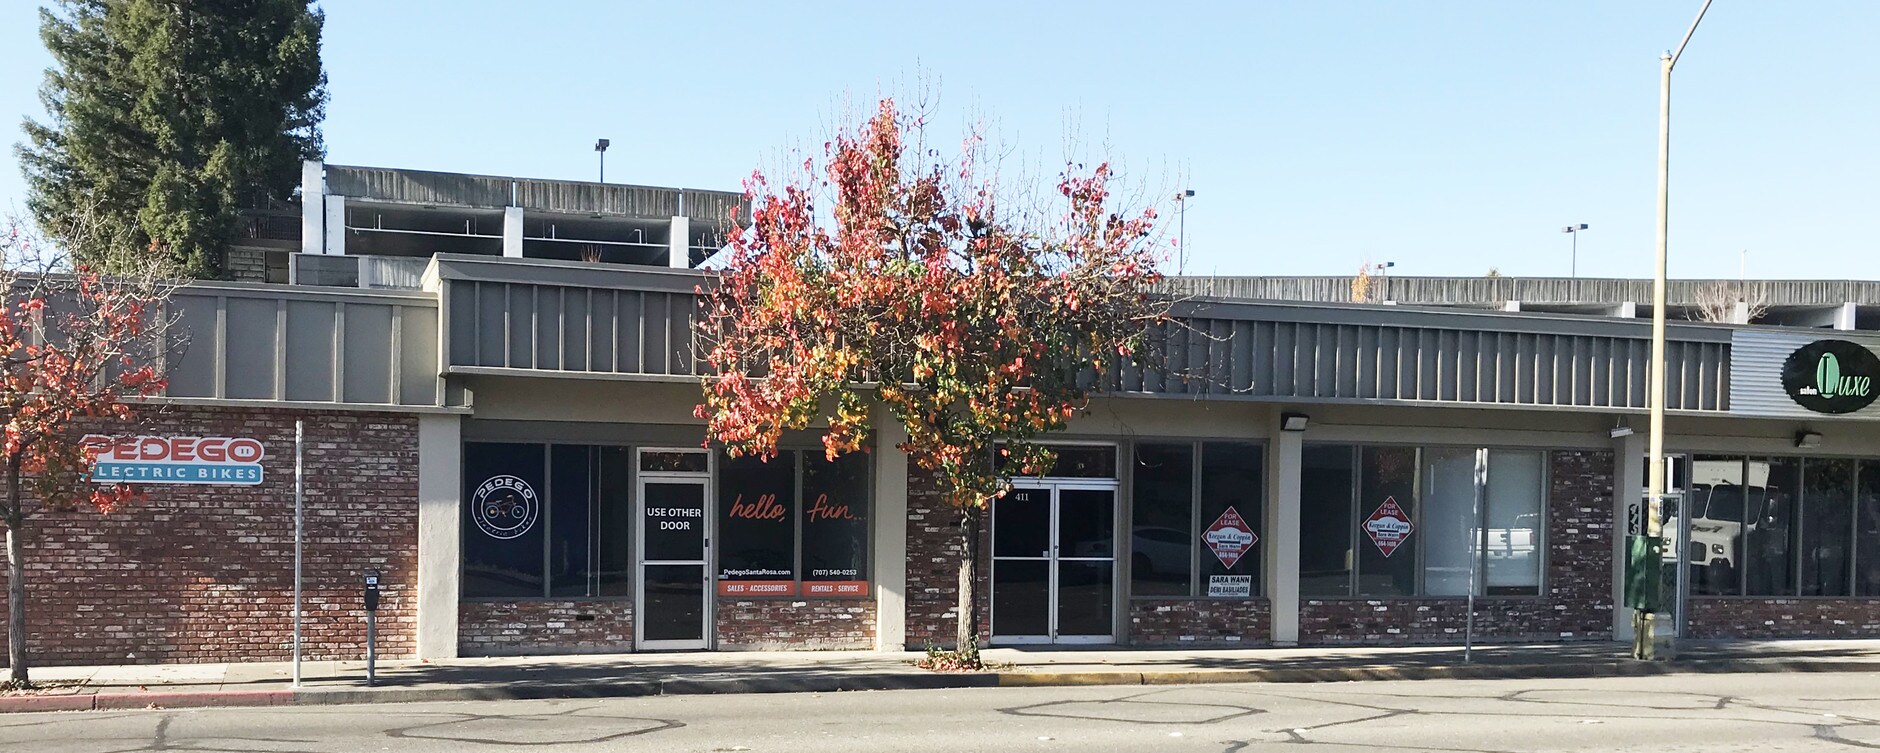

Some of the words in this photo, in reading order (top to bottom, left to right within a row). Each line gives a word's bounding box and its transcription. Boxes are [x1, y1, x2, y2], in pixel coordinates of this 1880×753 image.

[1800, 385, 1817, 395] salon
[1817, 352, 1870, 398] Luxe
[80, 437, 262, 463] PEDEGO
[97, 466, 187, 479] LECTRIC
[198, 468, 256, 479] BIKES
[478, 478, 533, 499] PEDEGO
[1015, 493, 1029, 501] 411
[647, 508, 667, 517] USE
[668, 508, 702, 518] OTHER
[729, 493, 786, 523] hello,
[1630, 504, 1639, 535] 415
[660, 521, 690, 530] DOOR
[1211, 576, 1229, 584] SARA
[1230, 576, 1250, 584] WANN
[727, 584, 744, 593] SALES
[749, 584, 788, 593] ACCESSORIES
[811, 585, 833, 593] RENTALS
[837, 585, 859, 593] SERVICE
